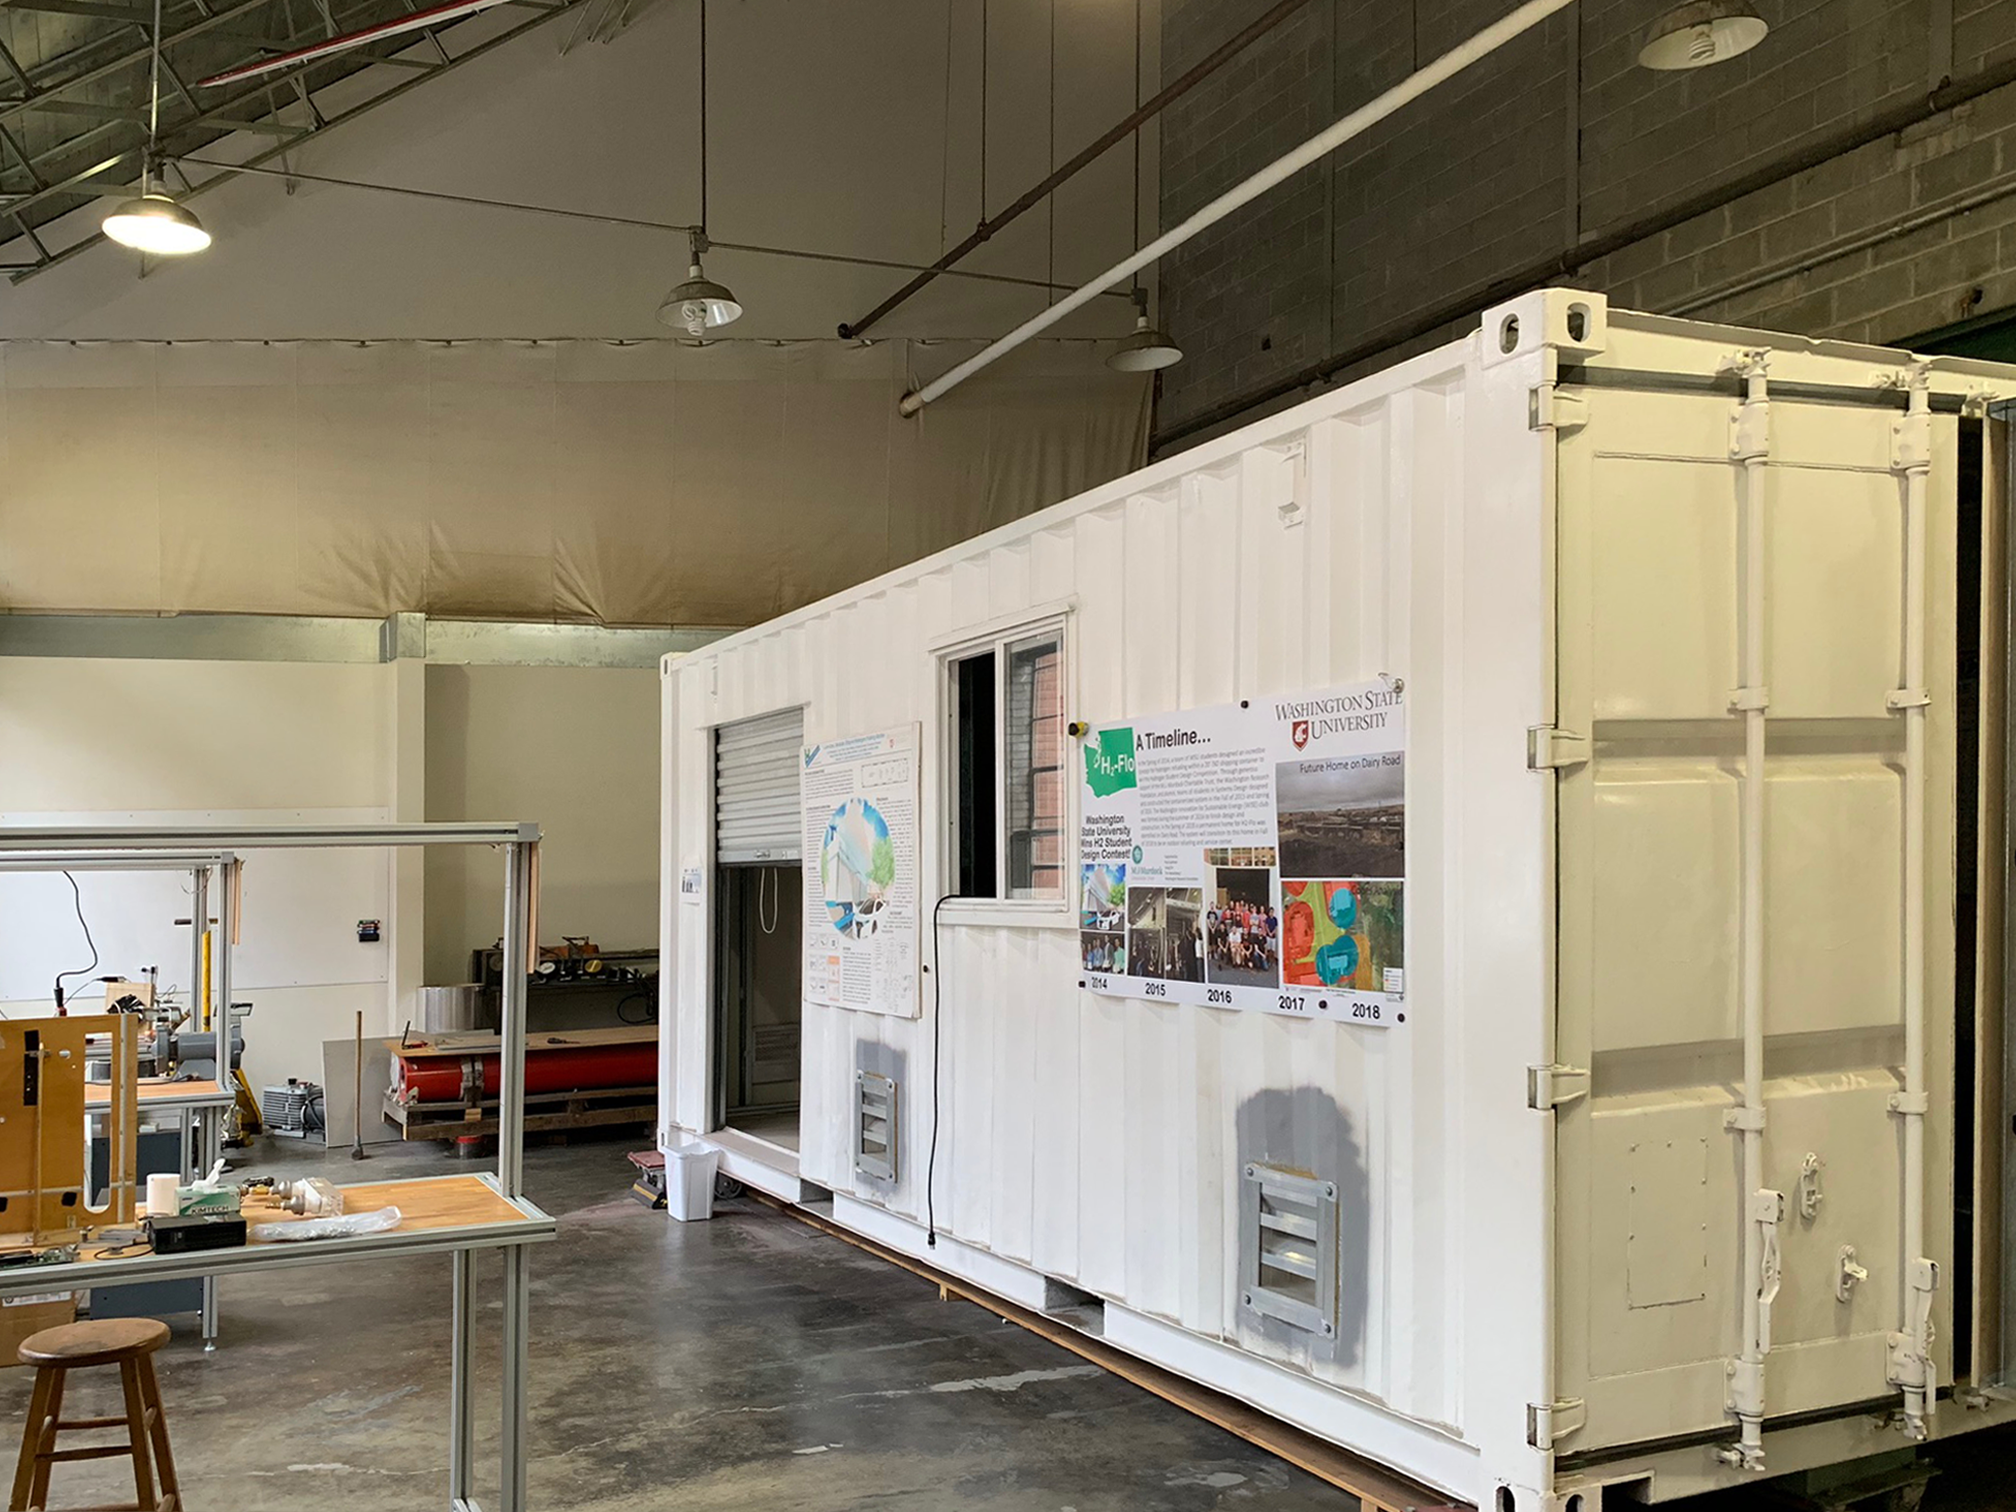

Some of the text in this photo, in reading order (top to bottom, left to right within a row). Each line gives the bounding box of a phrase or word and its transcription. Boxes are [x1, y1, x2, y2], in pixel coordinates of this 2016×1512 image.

[1275, 690, 1403, 721] WASHINGTON STATE
[1311, 712, 1388, 740] UNIVERSITY
[1136, 728, 1211, 751] A Timeline...
[1300, 755, 1401, 774] Future Home on Dairy Road
[1086, 815, 1125, 827] Washington
[1081, 826, 1095, 837] State
[1096, 825, 1131, 838] University
[1094, 837, 1104, 848] H2
[1105, 837, 1132, 848] Student
[1091, 976, 1108, 989] 2014
[1145, 982, 1166, 997] 2015
[1207, 989, 1233, 1004] 2016
[1278, 995, 1305, 1011] 2017
[1352, 1003, 1381, 1020] 2018
[191, 1205, 229, 1216] KIMTECH
